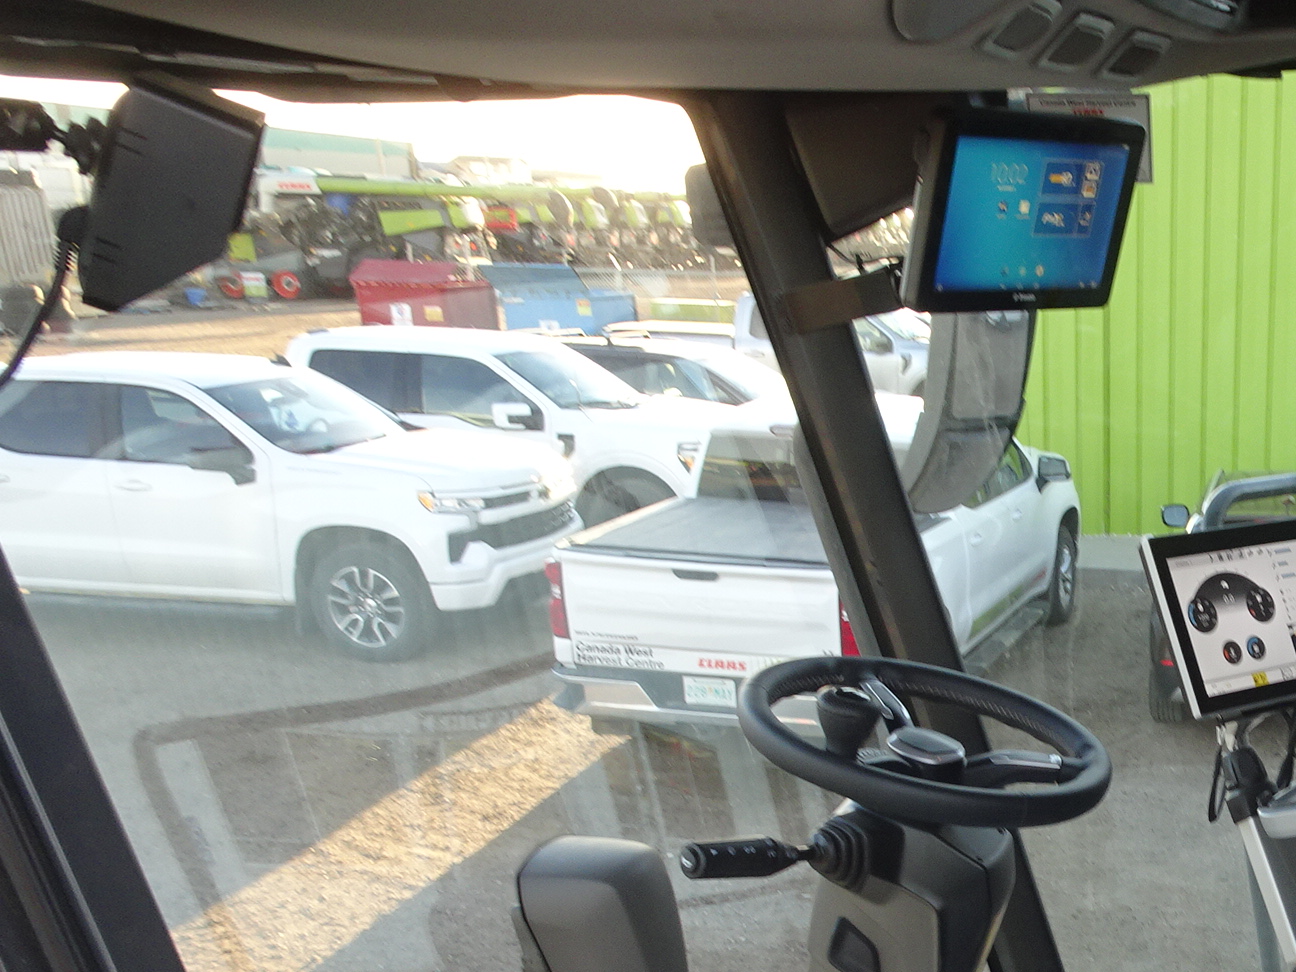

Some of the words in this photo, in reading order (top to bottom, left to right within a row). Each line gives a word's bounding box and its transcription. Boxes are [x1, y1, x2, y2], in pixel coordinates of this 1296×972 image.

[575, 641, 621, 656] Canada
[623, 644, 654, 658] West
[576, 653, 622, 667] Harvest
[625, 656, 665, 670] Centre
[697, 657, 747, 672] CLAAS
